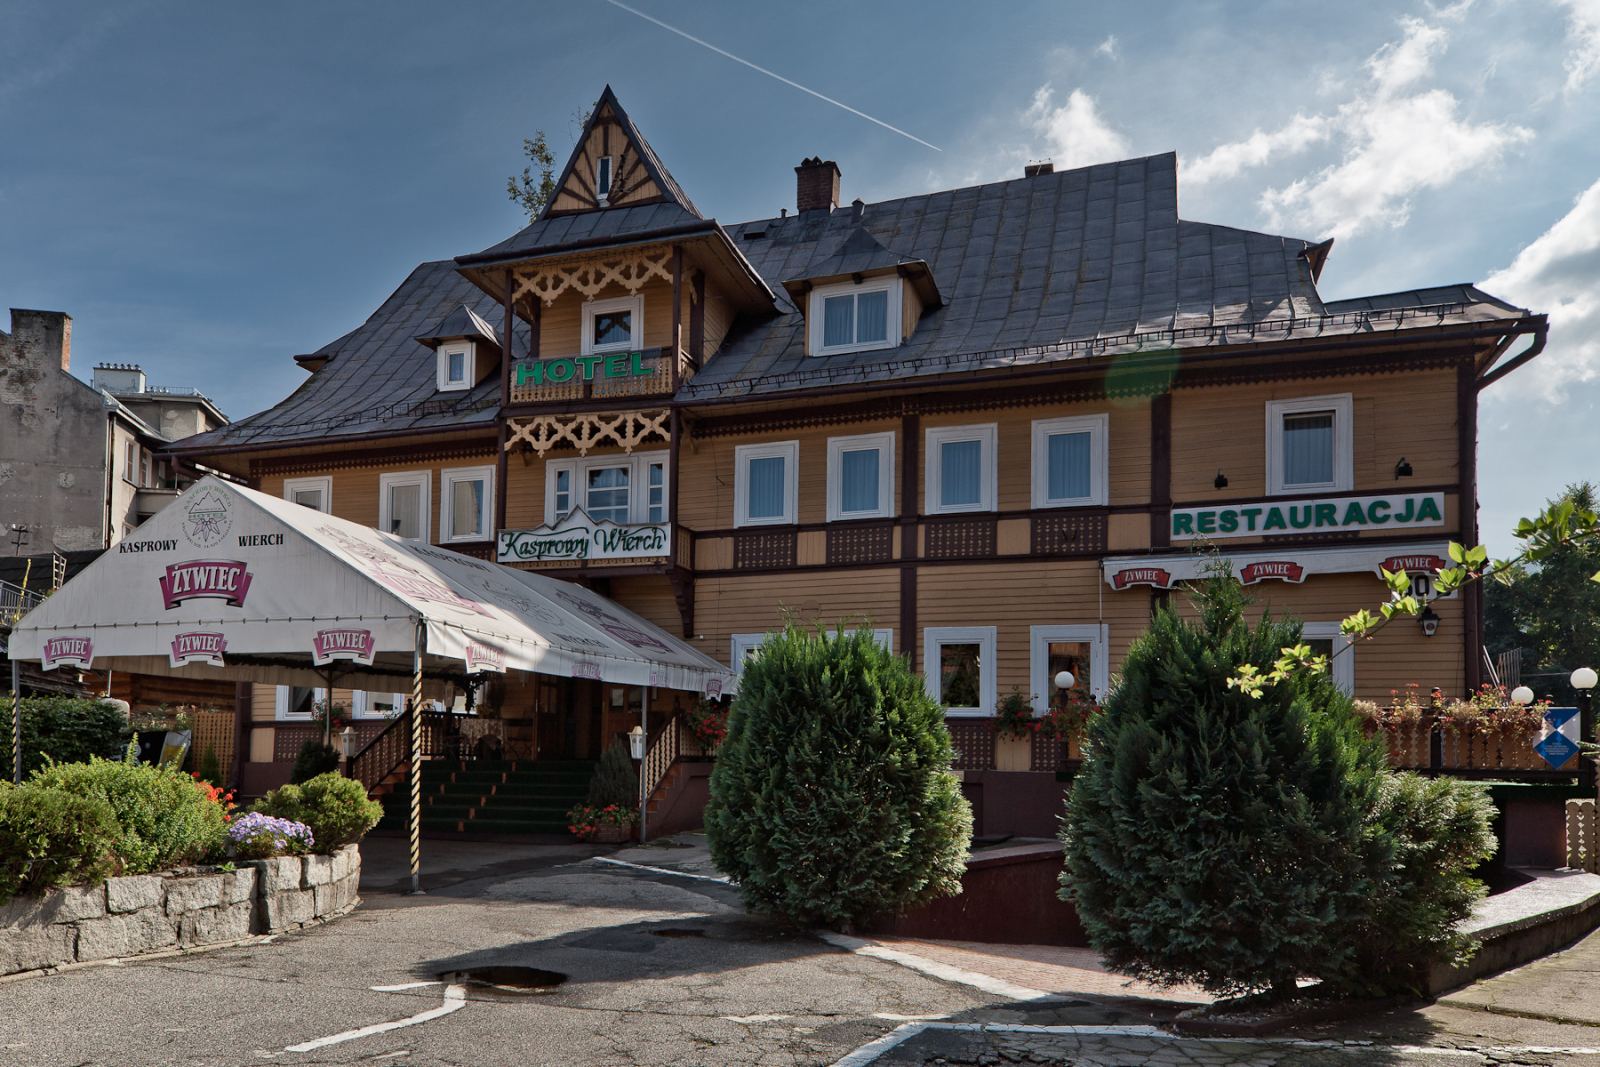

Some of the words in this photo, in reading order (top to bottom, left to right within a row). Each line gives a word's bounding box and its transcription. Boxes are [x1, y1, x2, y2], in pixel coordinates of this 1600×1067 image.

[516, 352, 655, 386] HOTEL
[1172, 497, 1442, 536] RESTAURACJA
[119, 539, 178, 554] KASPROWY
[238, 533, 284, 547] WIERCH
[499, 526, 589, 560] Kasprowy
[594, 526, 667, 553] Wierch
[171, 565, 241, 594] ŻYWIEC
